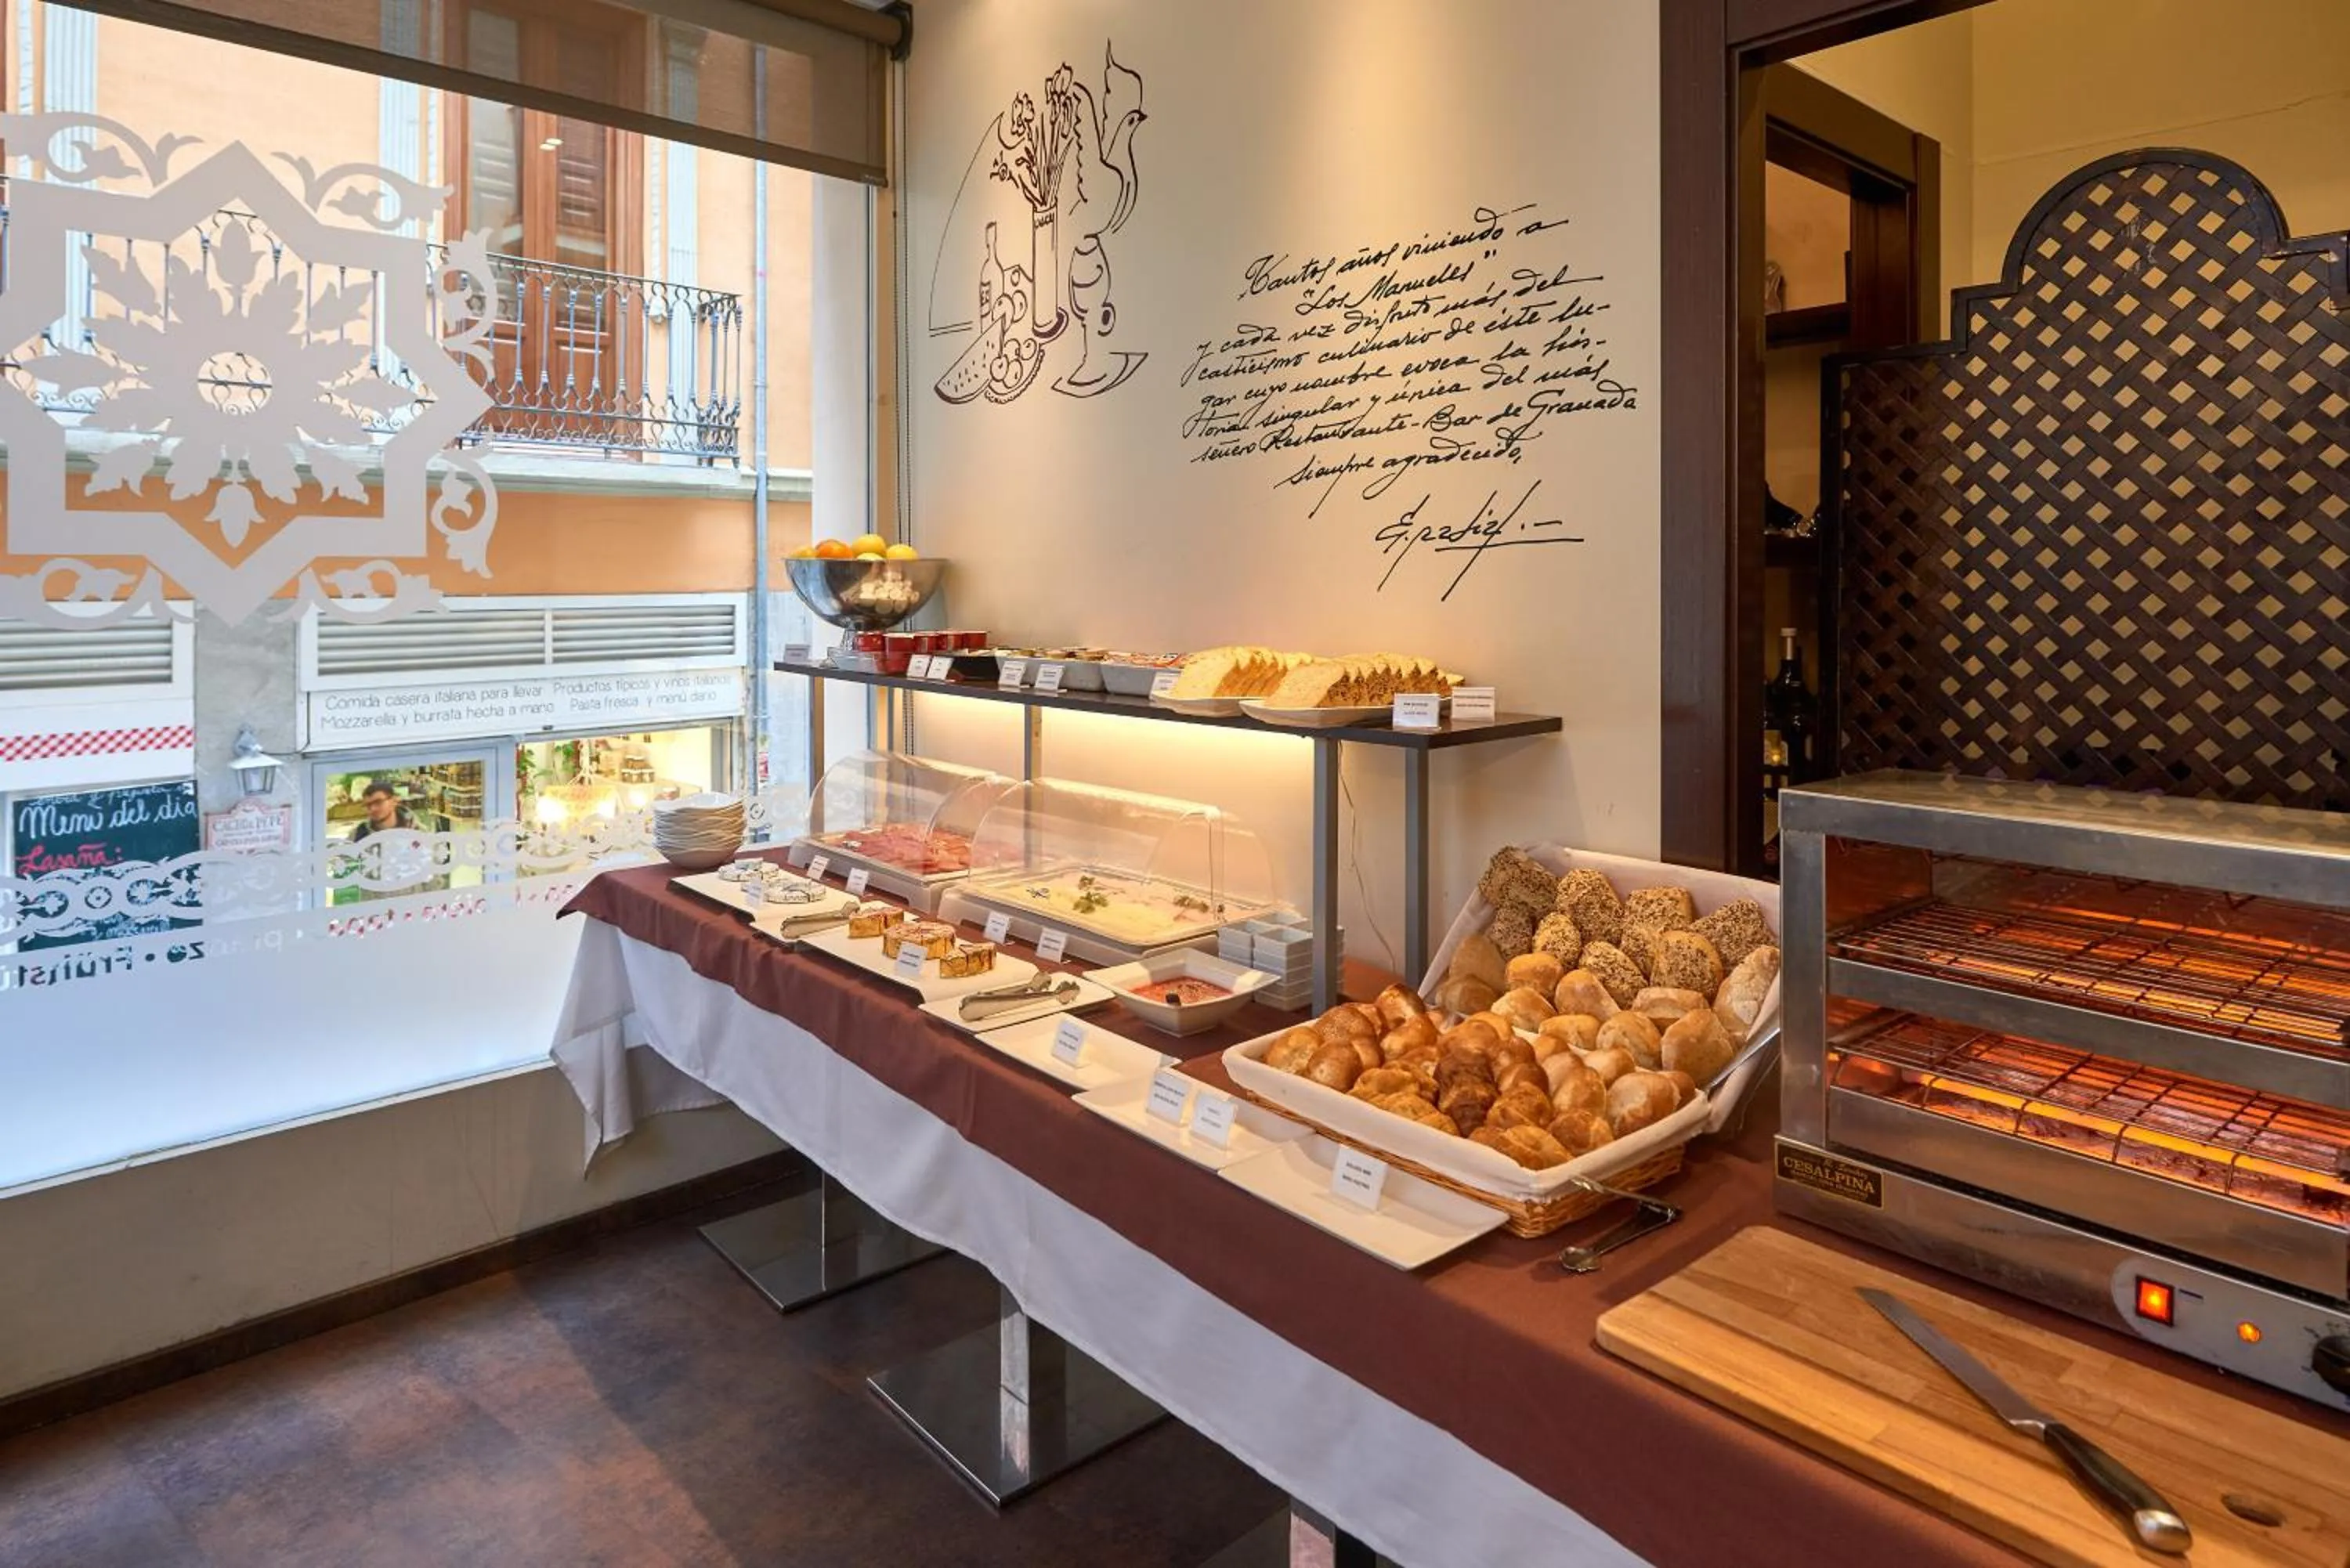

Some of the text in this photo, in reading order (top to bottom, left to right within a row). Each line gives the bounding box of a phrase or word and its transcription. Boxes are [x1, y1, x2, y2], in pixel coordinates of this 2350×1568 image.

[1517, 219, 1569, 236] a
[1220, 323, 1280, 352] cada
[1288, 324, 1335, 342] vez
[1509, 265, 1603, 298] del
[1444, 317, 1475, 340] de
[1290, 361, 1392, 392] nombre
[1401, 356, 1479, 377] evoca
[1491, 341, 1530, 360] la
[1480, 363, 1529, 390] del
[1524, 381, 1638, 429] Granada
[325, 694, 380, 711] Comida
[385, 692, 430, 706] casera
[435, 688, 477, 703] italiana
[480, 690, 508, 704] para
[513, 685, 543, 698] llevar
[553, 680, 612, 695] Productos
[663, 674, 690, 688] vinos
[320, 714, 396, 730] Mozzarella
[401, 714, 408, 725] y
[414, 708, 462, 724] burrata
[466, 705, 504, 720] hecha
[519, 701, 555, 714] mano
[569, 697, 602, 711] Pasta
[604, 695, 639, 710] fresca
[108, 800, 150, 828] del
[1784, 1157, 1875, 1193] CESALPINA
